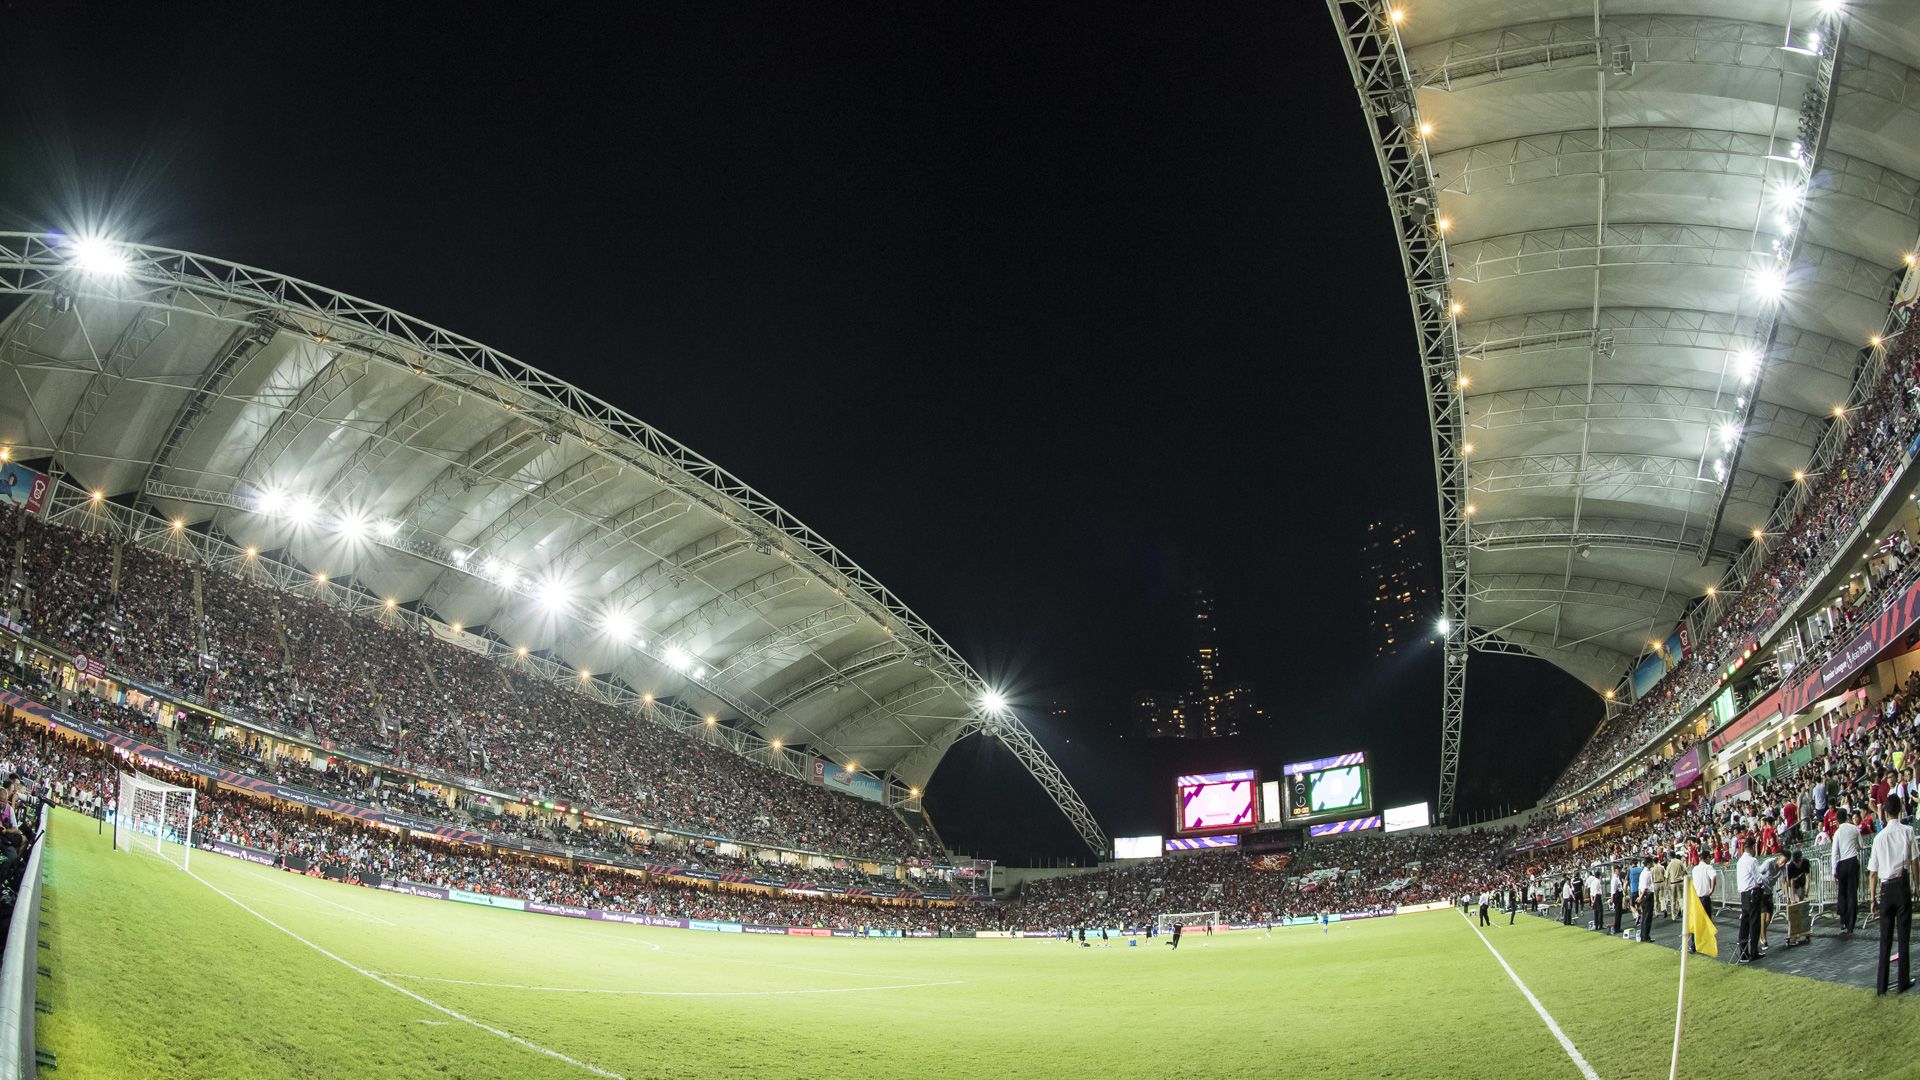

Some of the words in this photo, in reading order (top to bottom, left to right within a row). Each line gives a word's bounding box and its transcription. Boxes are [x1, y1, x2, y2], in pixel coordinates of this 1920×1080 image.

[602, 912, 623, 921] Premier
[623, 914, 644, 925] League
[652, 918, 664, 926] Asia
[664, 919, 681, 928] Trophy
